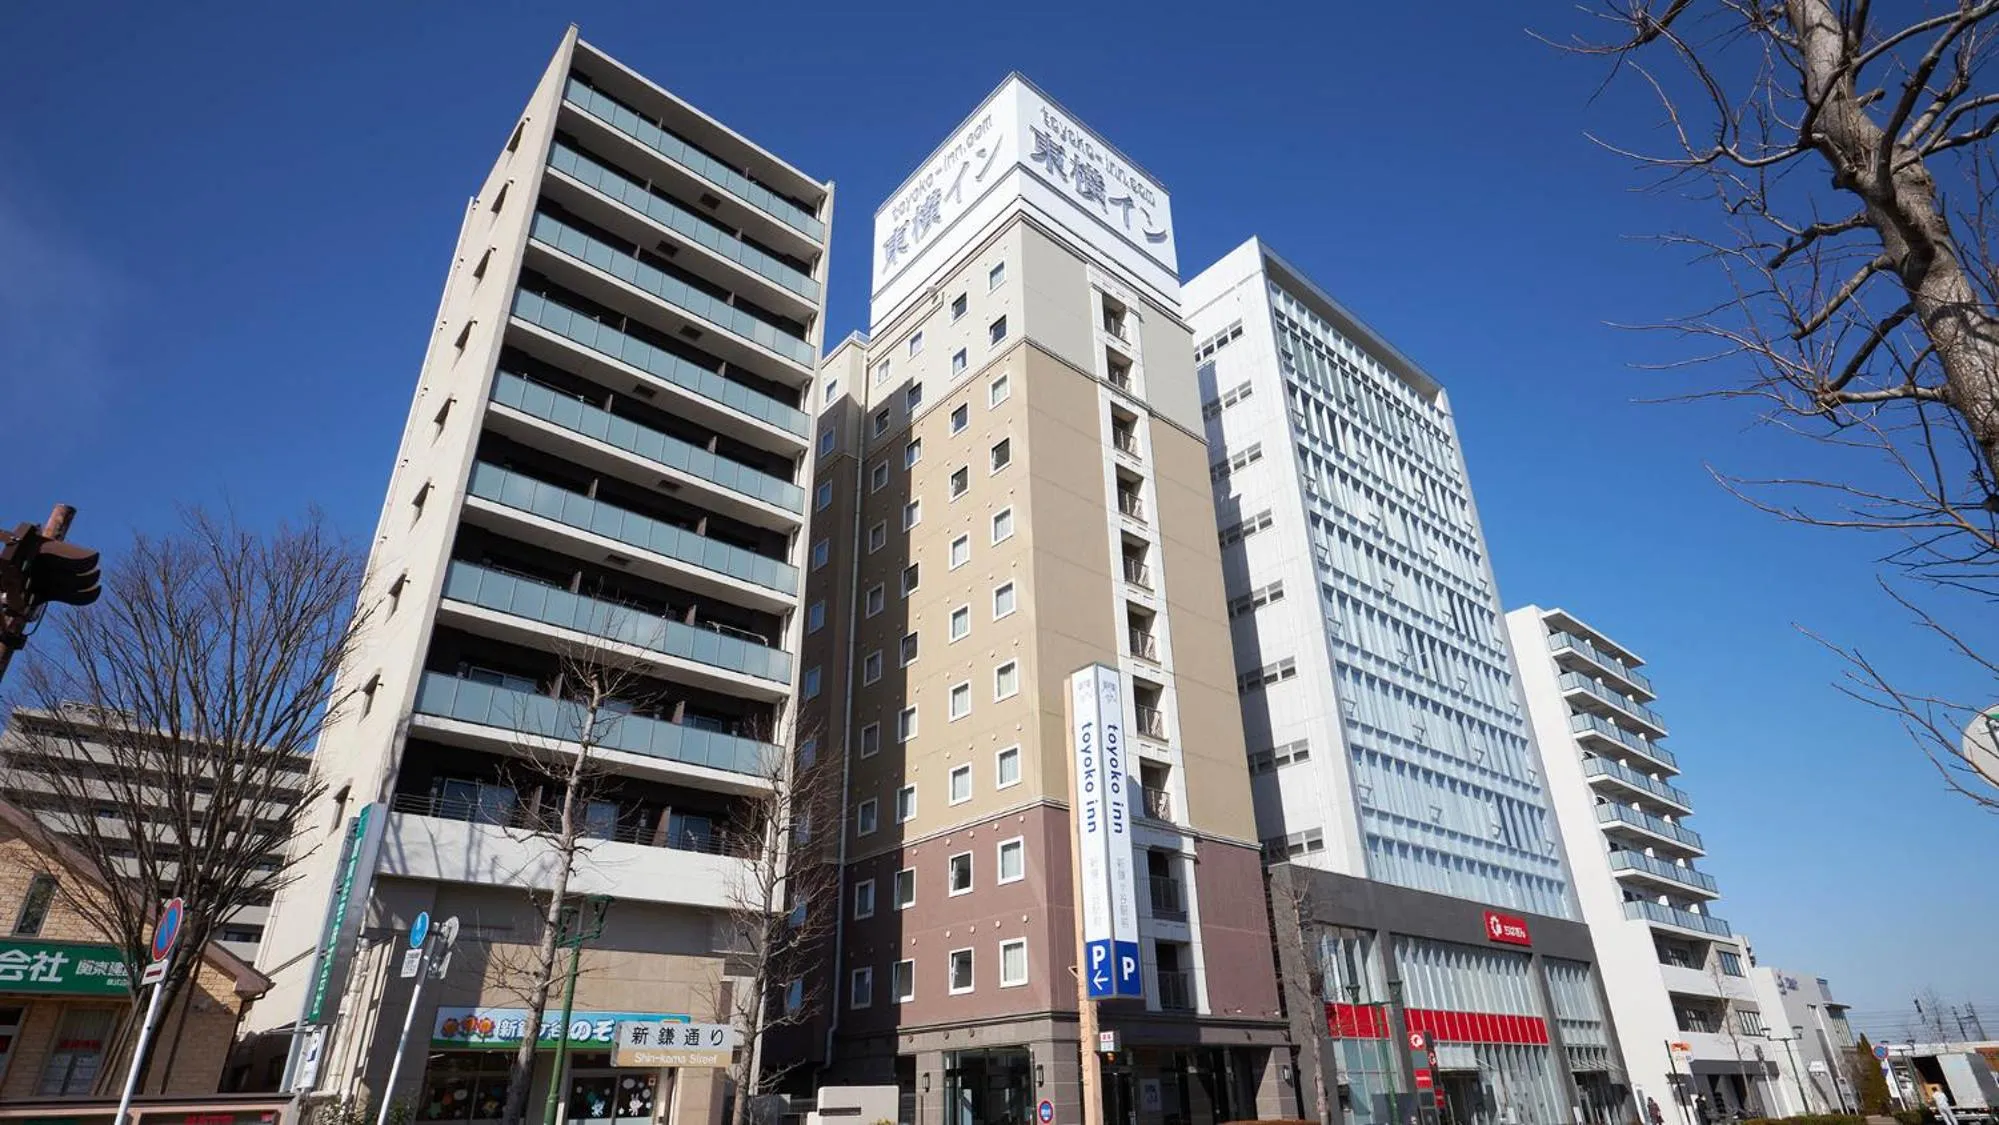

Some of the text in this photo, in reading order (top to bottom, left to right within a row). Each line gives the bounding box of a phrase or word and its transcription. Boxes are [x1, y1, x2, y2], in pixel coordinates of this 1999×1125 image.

[1081, 722, 1099, 833] toyoko inn
[1106, 724, 1124, 834] toyoko inn
[1092, 945, 1106, 970] P
[1122, 956, 1135, 981] P
[631, 1026, 724, 1046] 新鎌通り
[634, 1051, 718, 1065] Shin-kama Street
